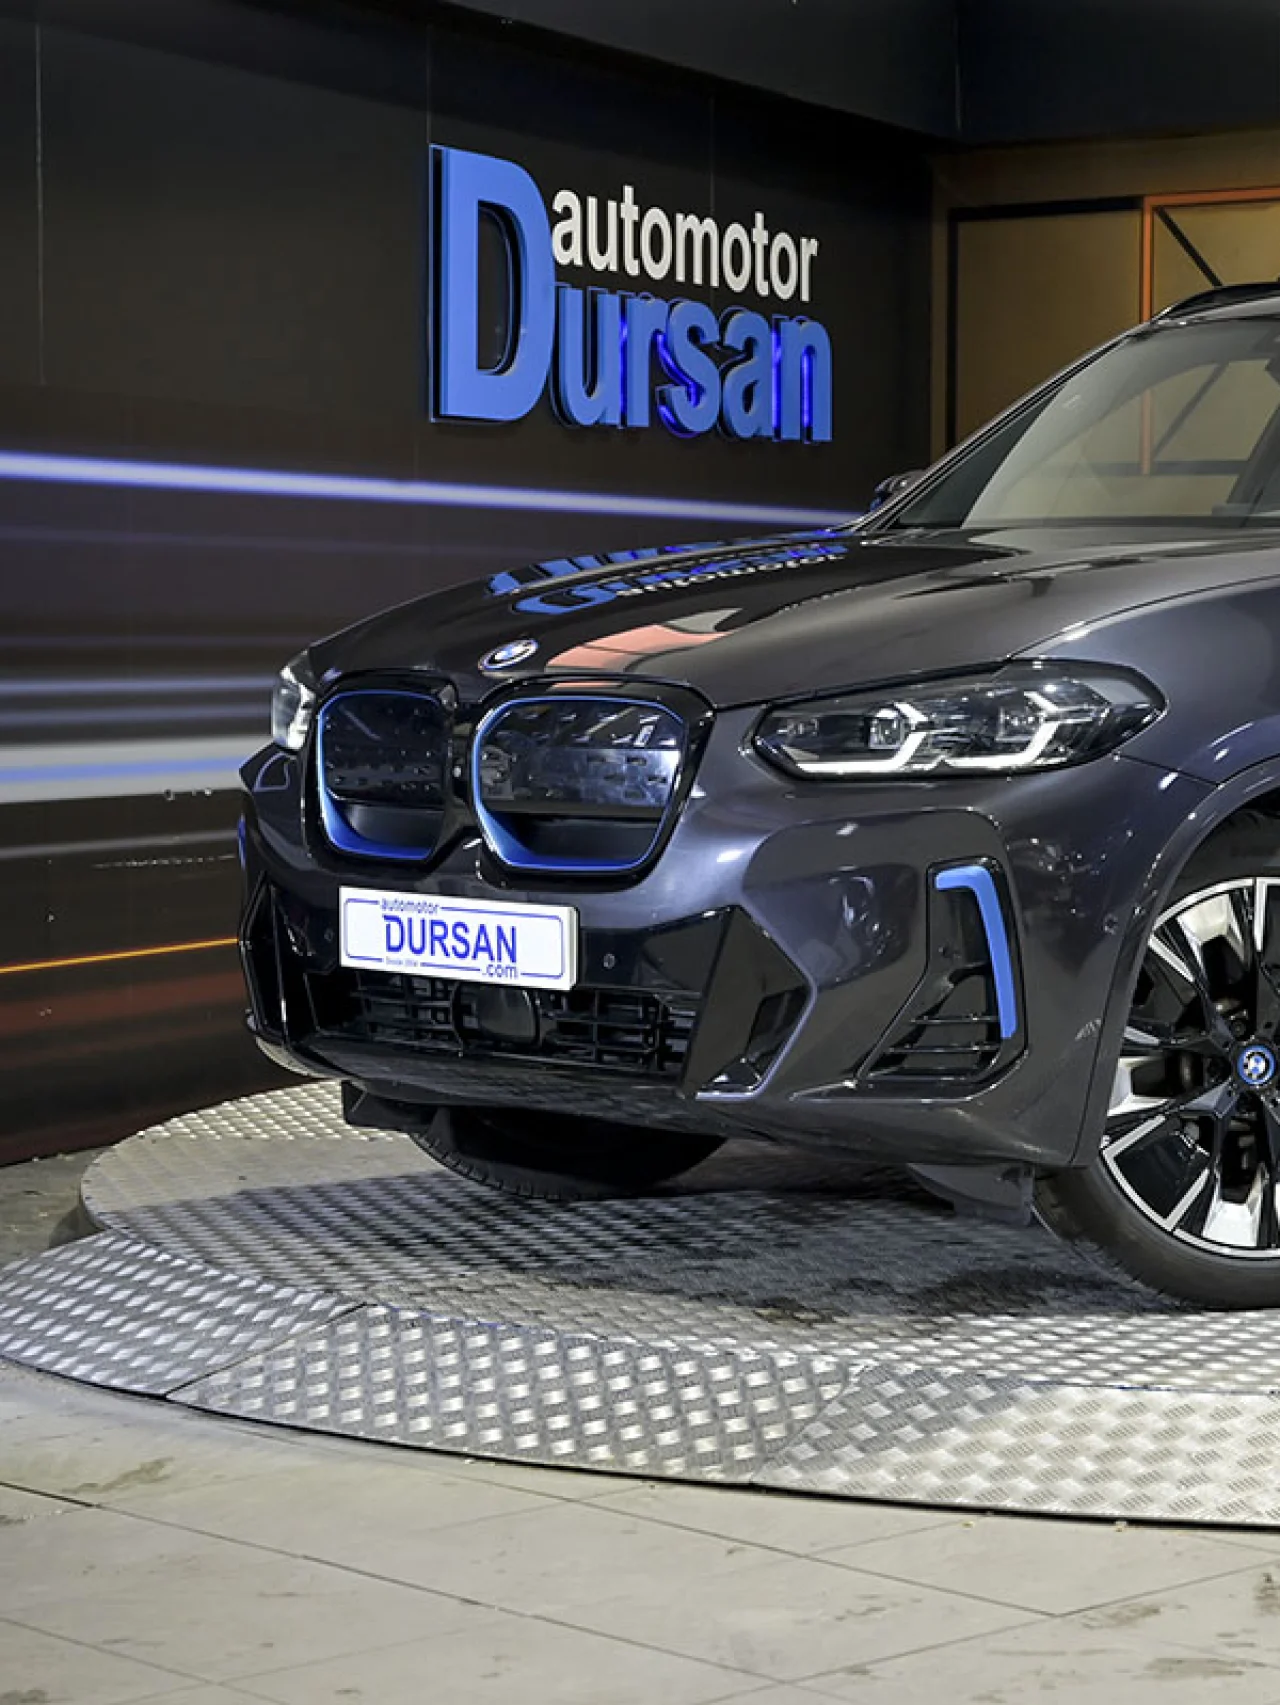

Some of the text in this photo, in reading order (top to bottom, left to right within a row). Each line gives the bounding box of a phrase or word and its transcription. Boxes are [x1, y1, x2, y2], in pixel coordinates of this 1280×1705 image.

[552, 185, 819, 302] automotor
[429, 143, 833, 444] Dursan
[382, 915, 517, 963] DURSAN
[482, 963, 518, 980] .com
